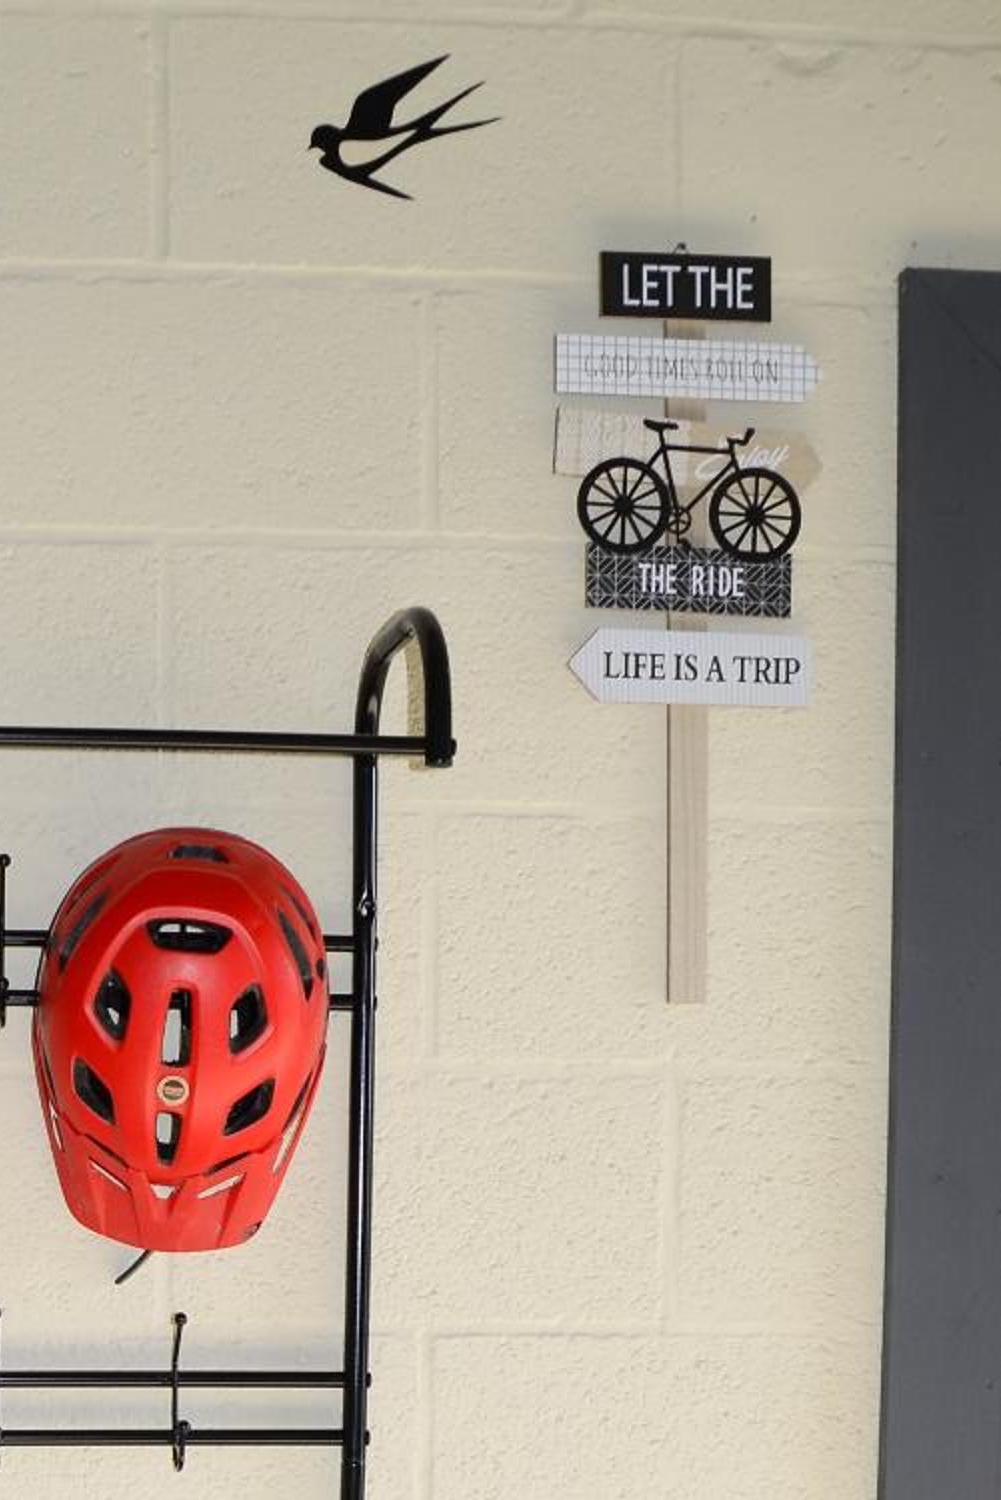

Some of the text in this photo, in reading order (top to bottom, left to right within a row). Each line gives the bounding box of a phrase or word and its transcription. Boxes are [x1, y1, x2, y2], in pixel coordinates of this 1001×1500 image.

[622, 263, 754, 309] LET THE
[639, 563, 744, 597] THE RIDE
[603, 652, 800, 684] LIFE IS A TRIP
